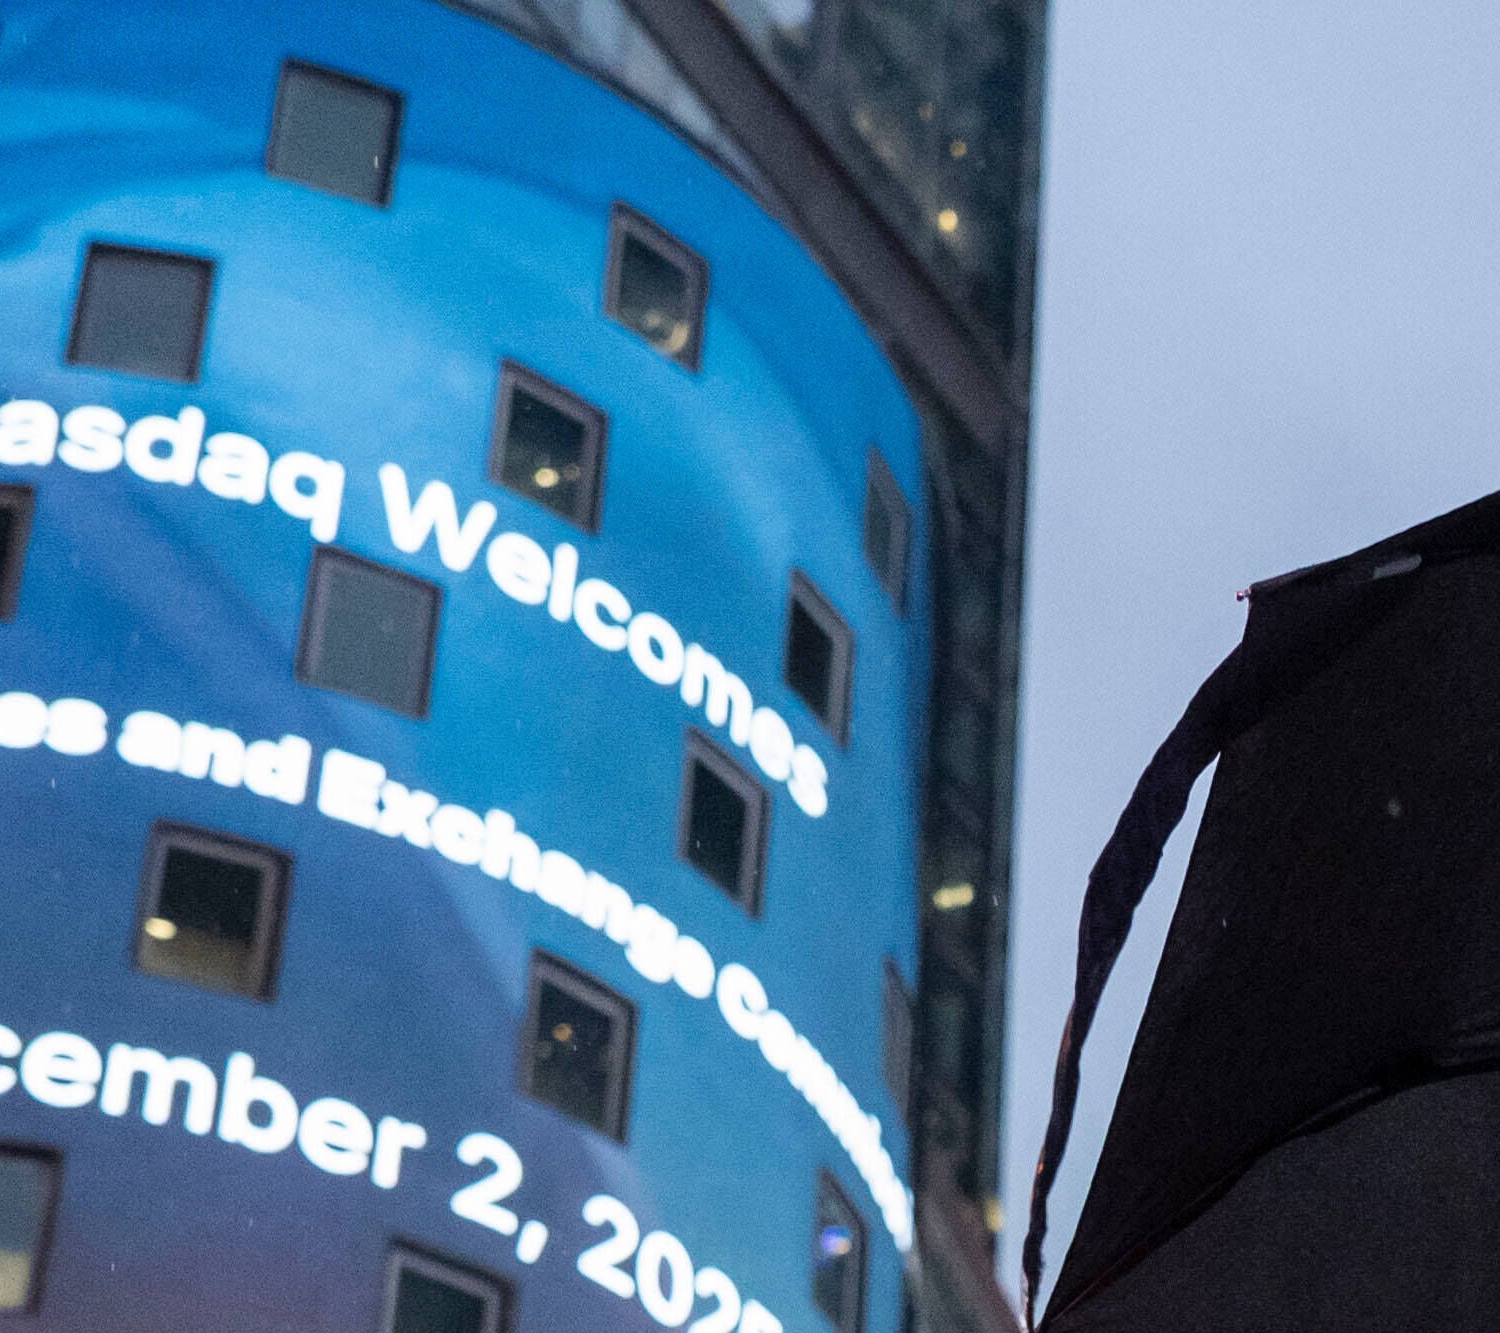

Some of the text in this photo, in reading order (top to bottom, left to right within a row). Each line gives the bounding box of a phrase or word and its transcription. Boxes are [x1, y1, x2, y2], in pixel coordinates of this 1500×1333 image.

[378, 462, 828, 817] Welcomes
[118, 710, 306, 806] and
[317, 749, 718, 1000] Exchange
[452, 1132, 549, 1264] 2,
